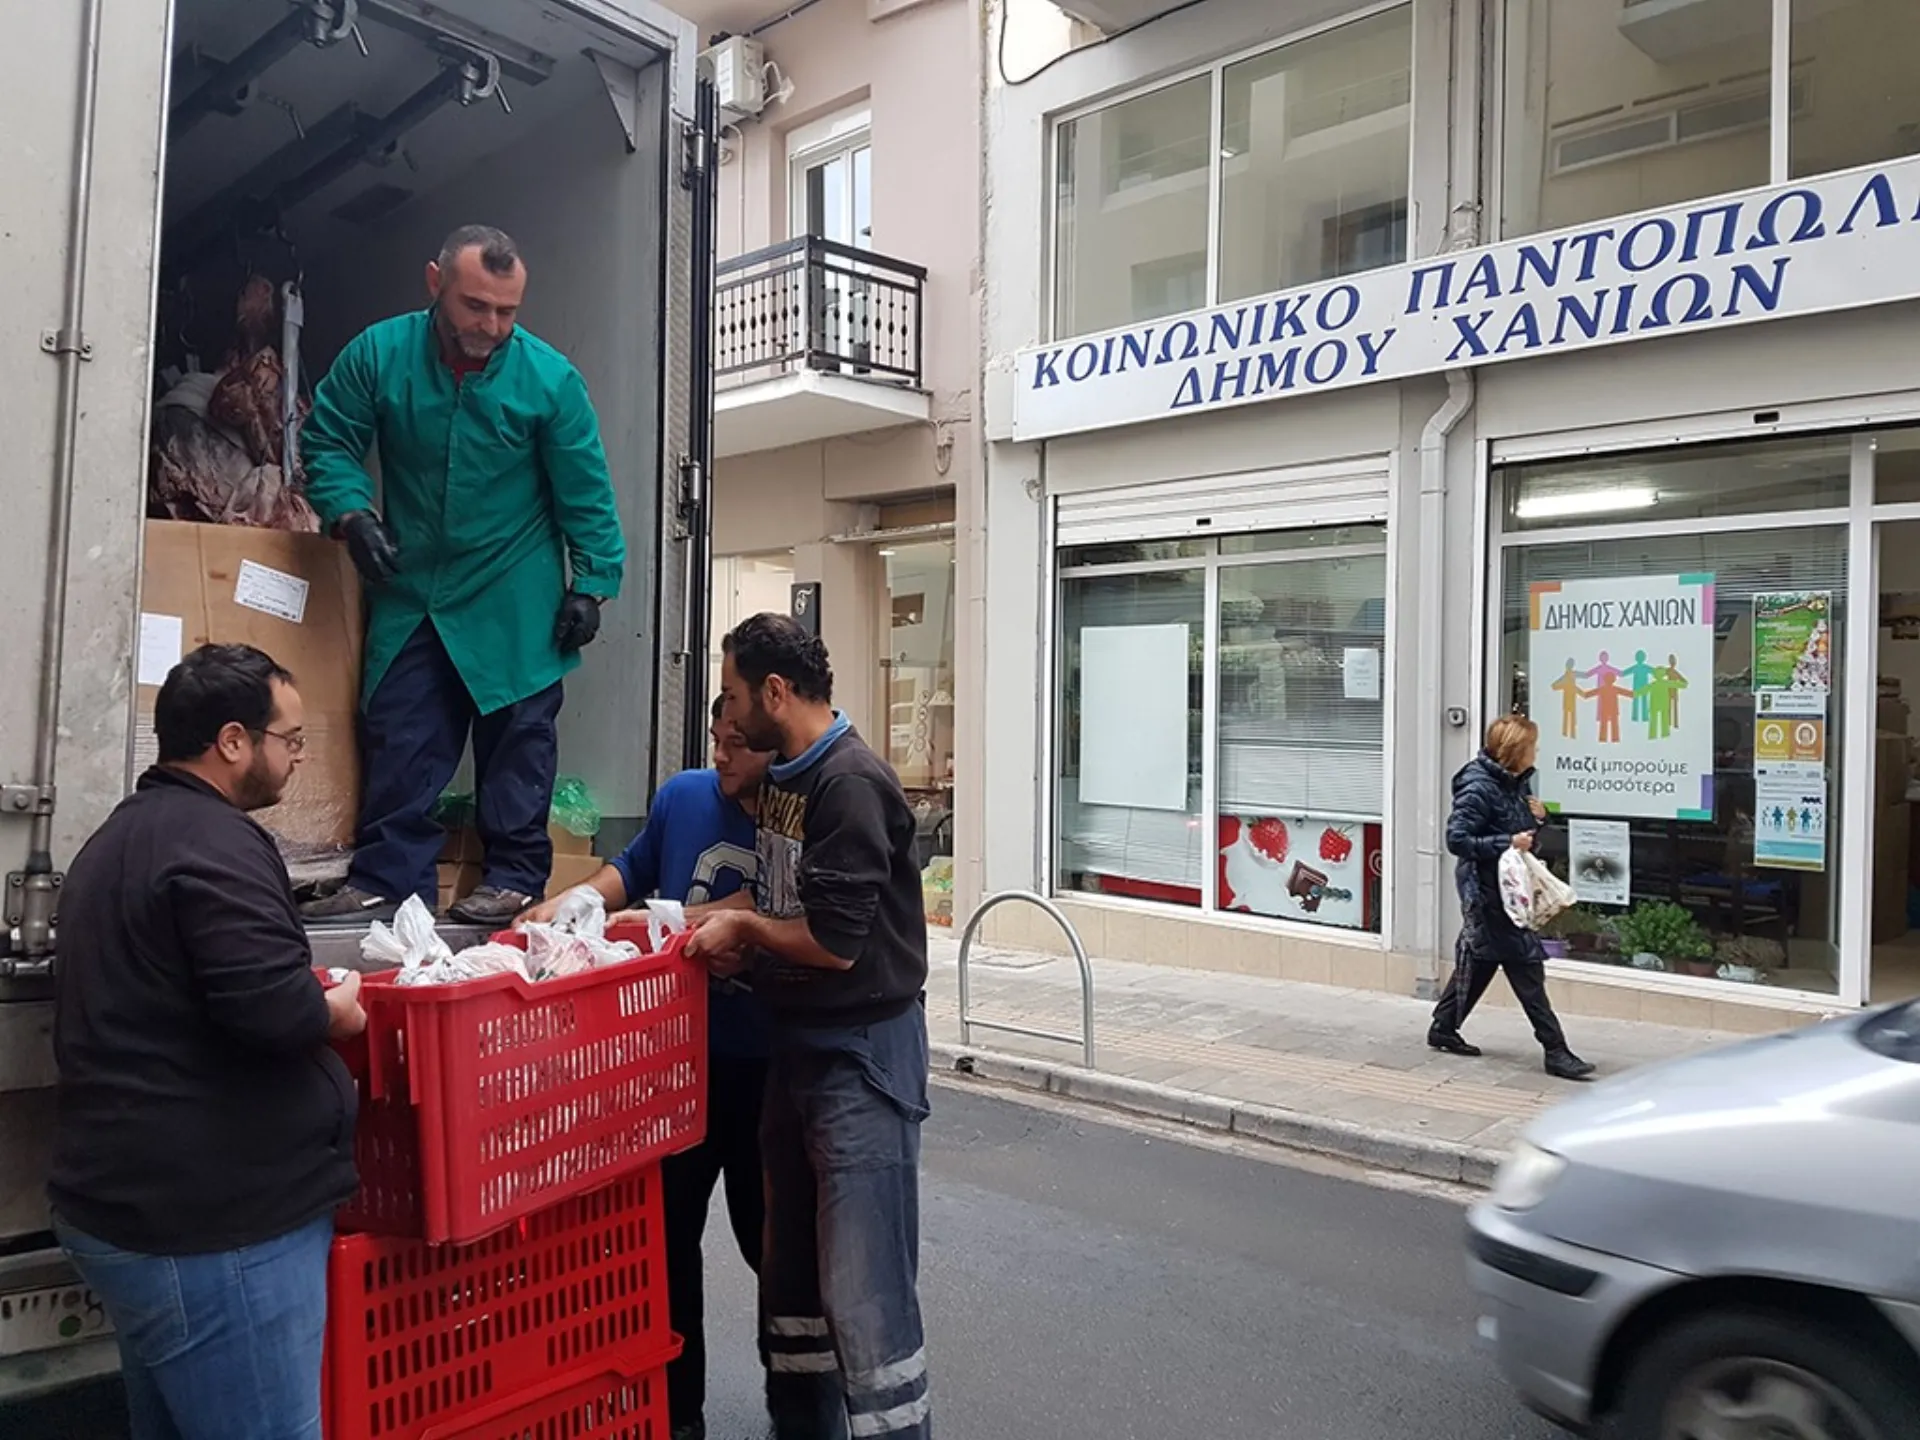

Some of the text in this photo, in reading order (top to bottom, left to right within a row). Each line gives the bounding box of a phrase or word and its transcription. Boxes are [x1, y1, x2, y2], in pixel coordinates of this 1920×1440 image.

[1032, 172, 1920, 389] ΚΟΙΝΩΝΙΚΟ ΠΑΝΤΟΠΩΛ
[1169, 257, 1792, 410] ΔΗΜΟΥ ΧΑΝΙΩΝ
[1544, 597, 1696, 631] ΔΗΜΟΣ ΧΑΝΙΩΝ
[1556, 756, 1689, 777] Μαζί μπορούμε
[1567, 777, 1676, 796] περισσότερα
